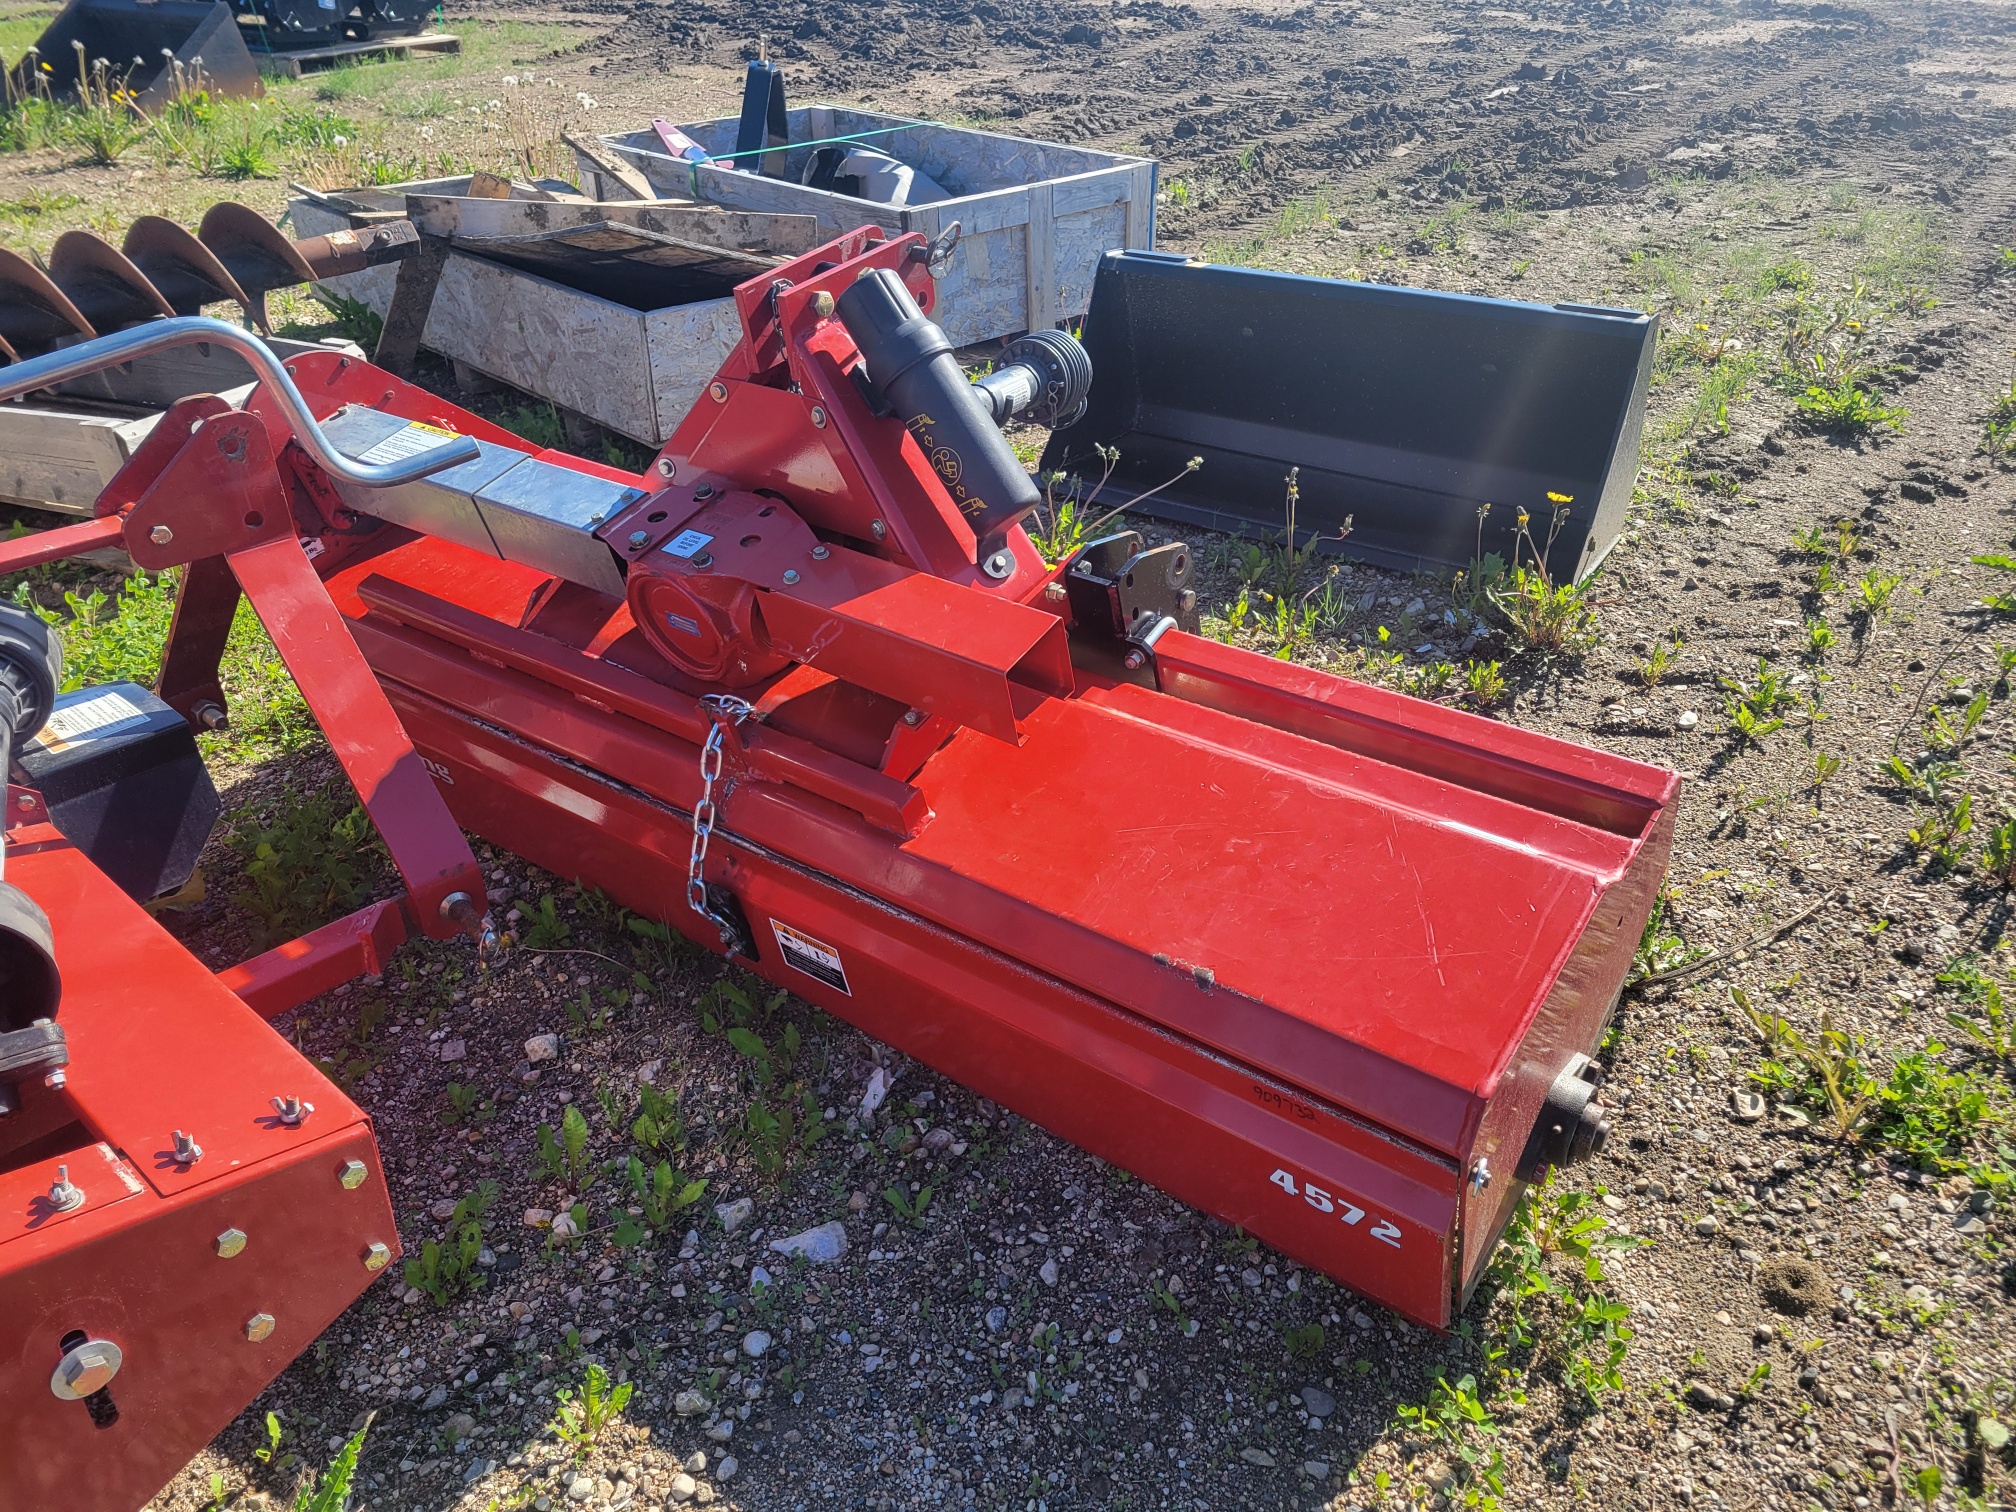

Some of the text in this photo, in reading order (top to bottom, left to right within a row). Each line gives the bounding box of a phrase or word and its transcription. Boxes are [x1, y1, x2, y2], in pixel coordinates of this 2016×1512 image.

[428, 426, 450, 437] CAUTION
[795, 933, 829, 954] WARNING
[1253, 1086, 1320, 1126] 909732
[1269, 1168, 1402, 1249] 4572
